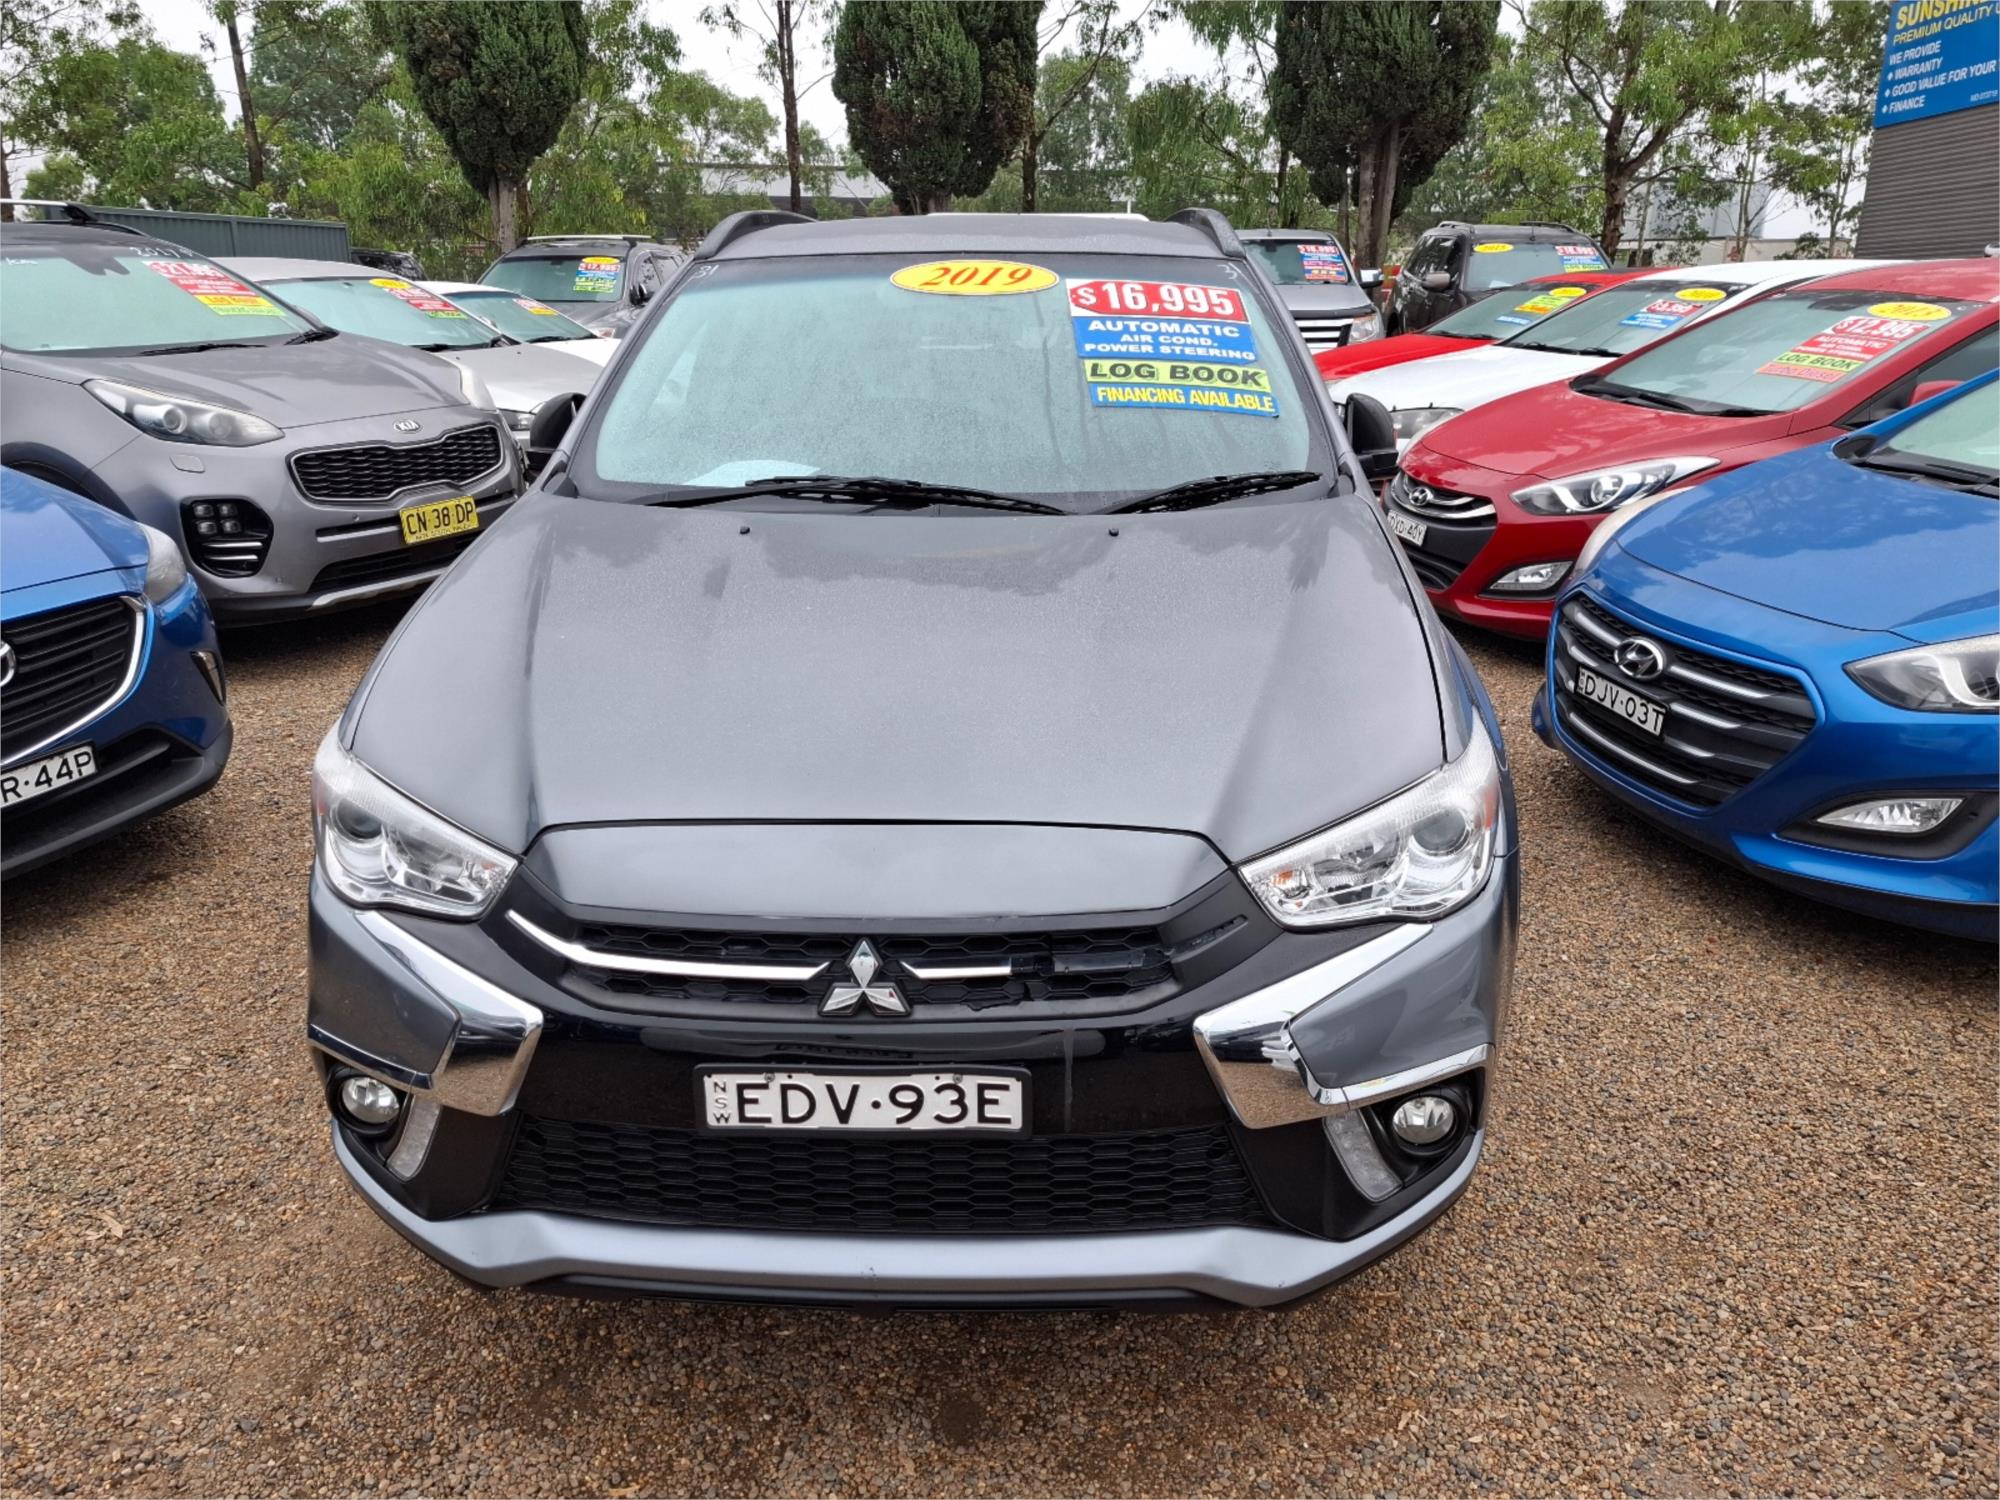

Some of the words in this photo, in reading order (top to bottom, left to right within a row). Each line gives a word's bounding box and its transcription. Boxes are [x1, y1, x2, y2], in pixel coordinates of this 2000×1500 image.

[1893, 21, 1941, 46] PREMIUM
[1943, 4, 1994, 30] QUALITY
[1889, 52, 1903, 65] WE
[1903, 40, 1942, 61] PROVIDE
[1892, 81, 1917, 97] GOOD
[1919, 73, 1947, 91] VALUE
[1947, 67, 1968, 83] FOR
[1969, 59, 1996, 77] YOUR
[1895, 57, 1943, 79] WARRANTY
[1889, 95, 1926, 114] FINANCE
[919, 267, 1033, 286] 2019
[1088, 320, 1240, 338] AUTOMATIC
[1120, 333, 1155, 344] AIR
[1158, 335, 1218, 347] COND.
[1814, 335, 1888, 349] AUTOMATIC
[1084, 343, 1155, 354] POWER
[1159, 344, 1256, 360] STEERING
[1778, 352, 1806, 362] LOG
[1808, 356, 1856, 369] BOOK
[1090, 363, 1158, 380] LOG
[1169, 364, 1263, 388] BOOK
[1097, 387, 1185, 404] FINANCING
[1189, 388, 1276, 412] AVAILABLE
[406, 511, 428, 535] CN
[432, 506, 451, 529] 38
[455, 501, 474, 524] DP
